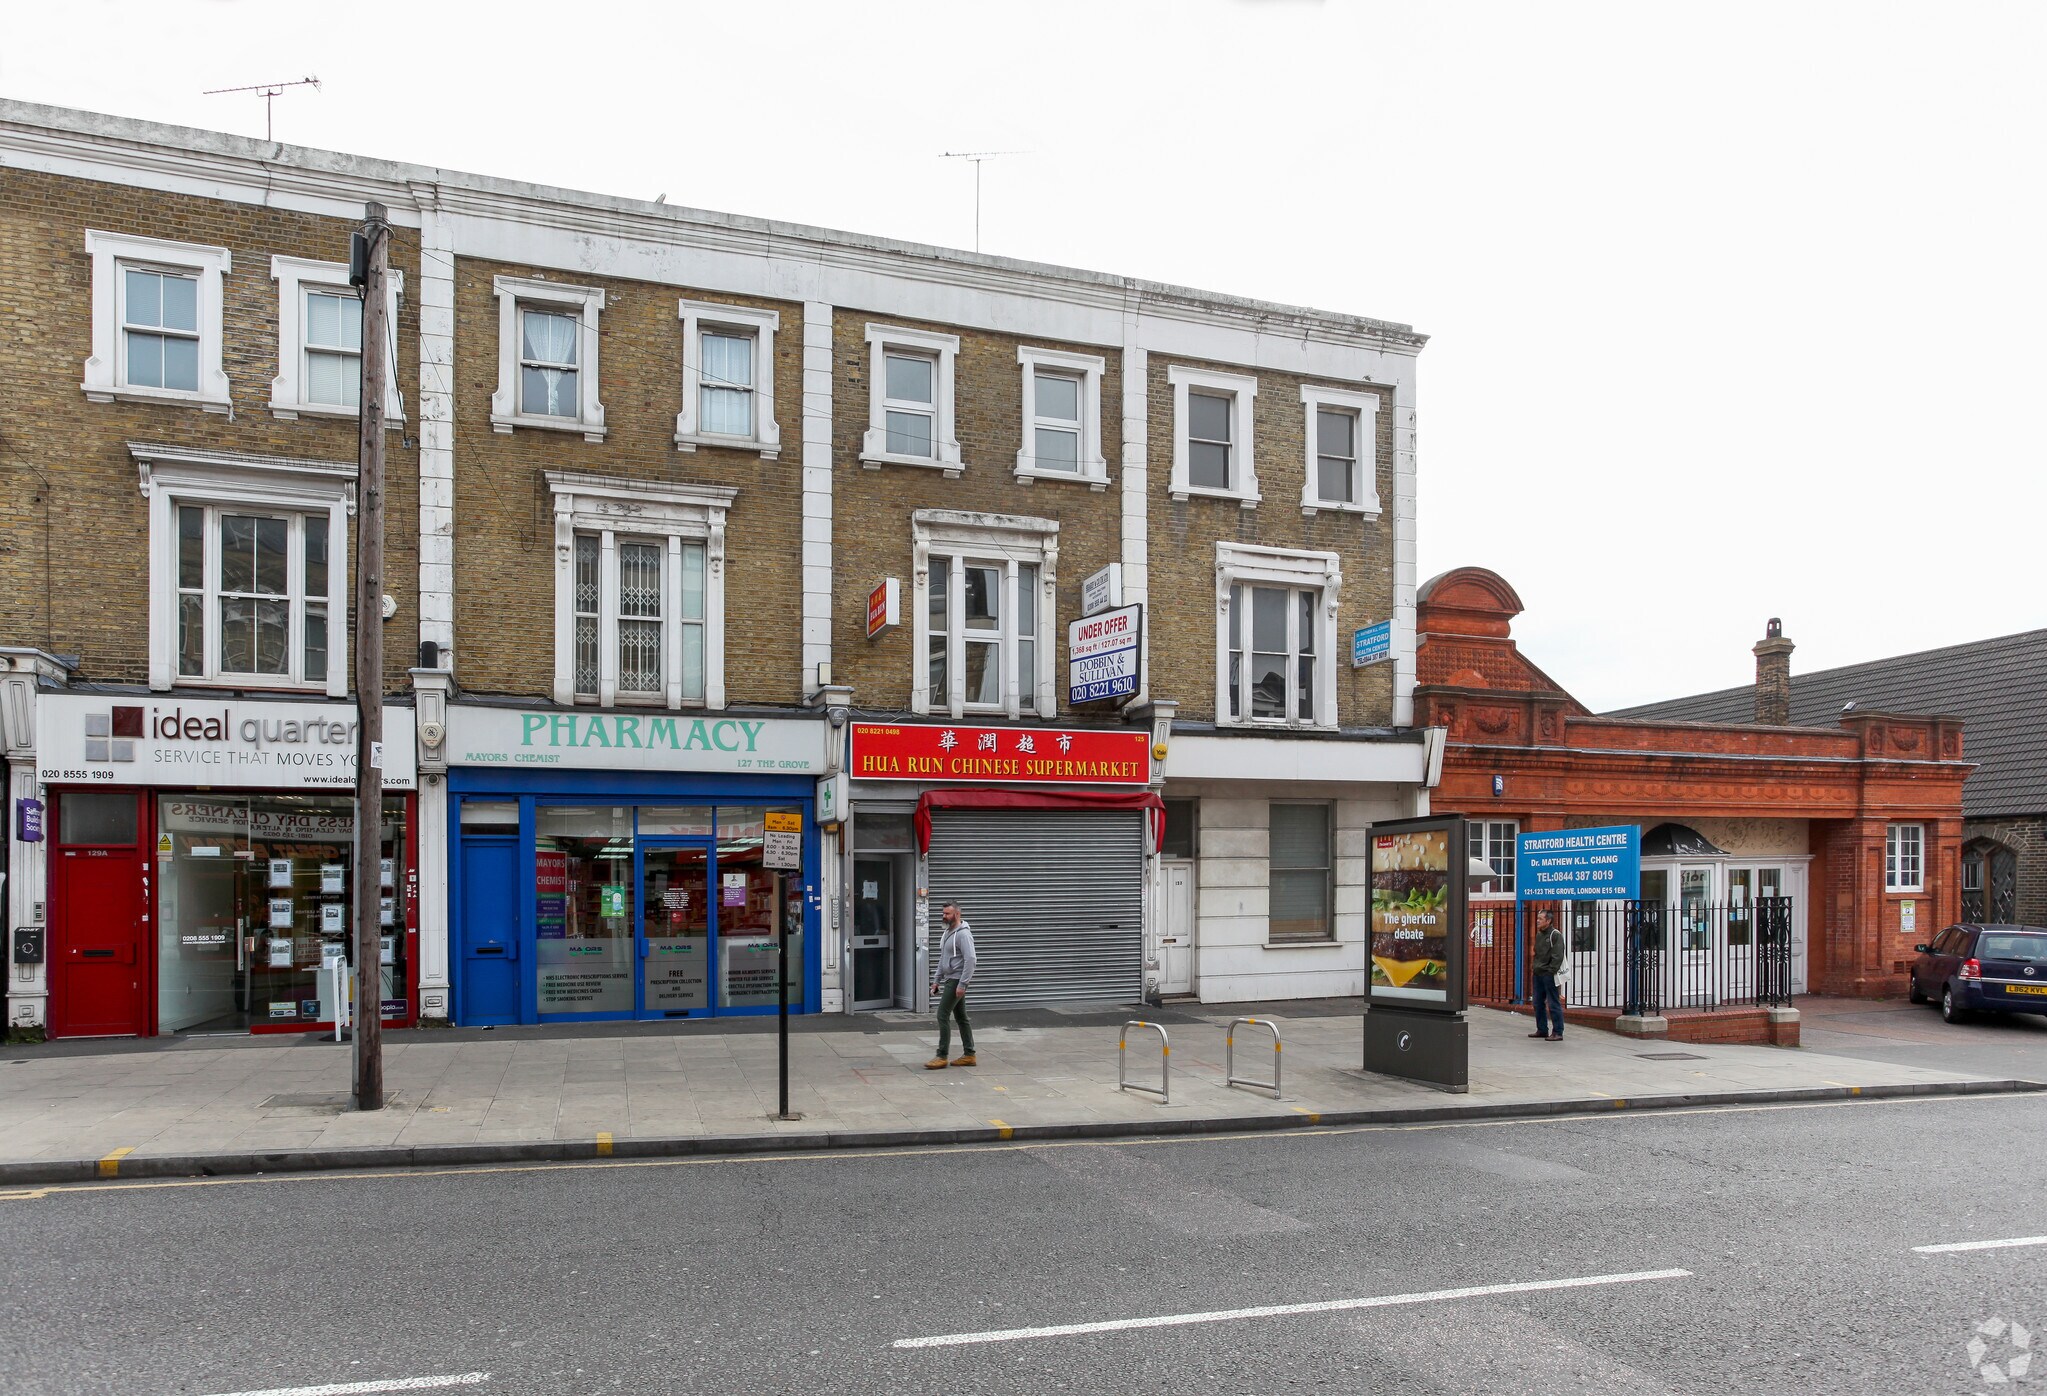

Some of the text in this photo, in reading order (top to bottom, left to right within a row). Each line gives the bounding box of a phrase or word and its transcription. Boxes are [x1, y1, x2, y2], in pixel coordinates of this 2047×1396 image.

[1078, 616, 1127, 641] UNDER OFFER
[1072, 646, 1084, 655] 1,368
[1101, 638, 1118, 648] 127.07
[1356, 633, 1389, 648] STRATFORD
[1356, 642, 1388, 656] HEALTH CENTRE
[1079, 653, 1124, 672] DOBBIN &
[1080, 664, 1124, 683] SULLIVAN
[1072, 677, 1132, 701] 020 8221 9610
[153, 706, 357, 750] ideal quarter
[521, 714, 765, 751] PHARMACY
[937, 730, 1073, 755] 華潤超市
[154, 750, 221, 763] SERVICE
[227, 751, 269, 765] THAT
[277, 752, 333, 766] MOVES
[465, 753, 560, 763] MAYORS CHEMIST
[738, 759, 809, 769] 127 THE GROVE
[863, 755, 1139, 777] HUA RUN CHINESE SUPERMARKET
[42, 770, 114, 779] 020 8555 1909
[1524, 833, 1627, 850] STRATFORD HEALTH CENTRE
[536, 859, 565, 868] MAYORS
[1541, 858, 1572, 866] MATHEW
[1590, 855, 1618, 864] CHANG
[536, 876, 565, 885] CHEMIST
[1537, 870, 1613, 882] TEL:0844 387 8019
[1384, 912, 1436, 928] The gherkin
[1394, 928, 1424, 940] debate
